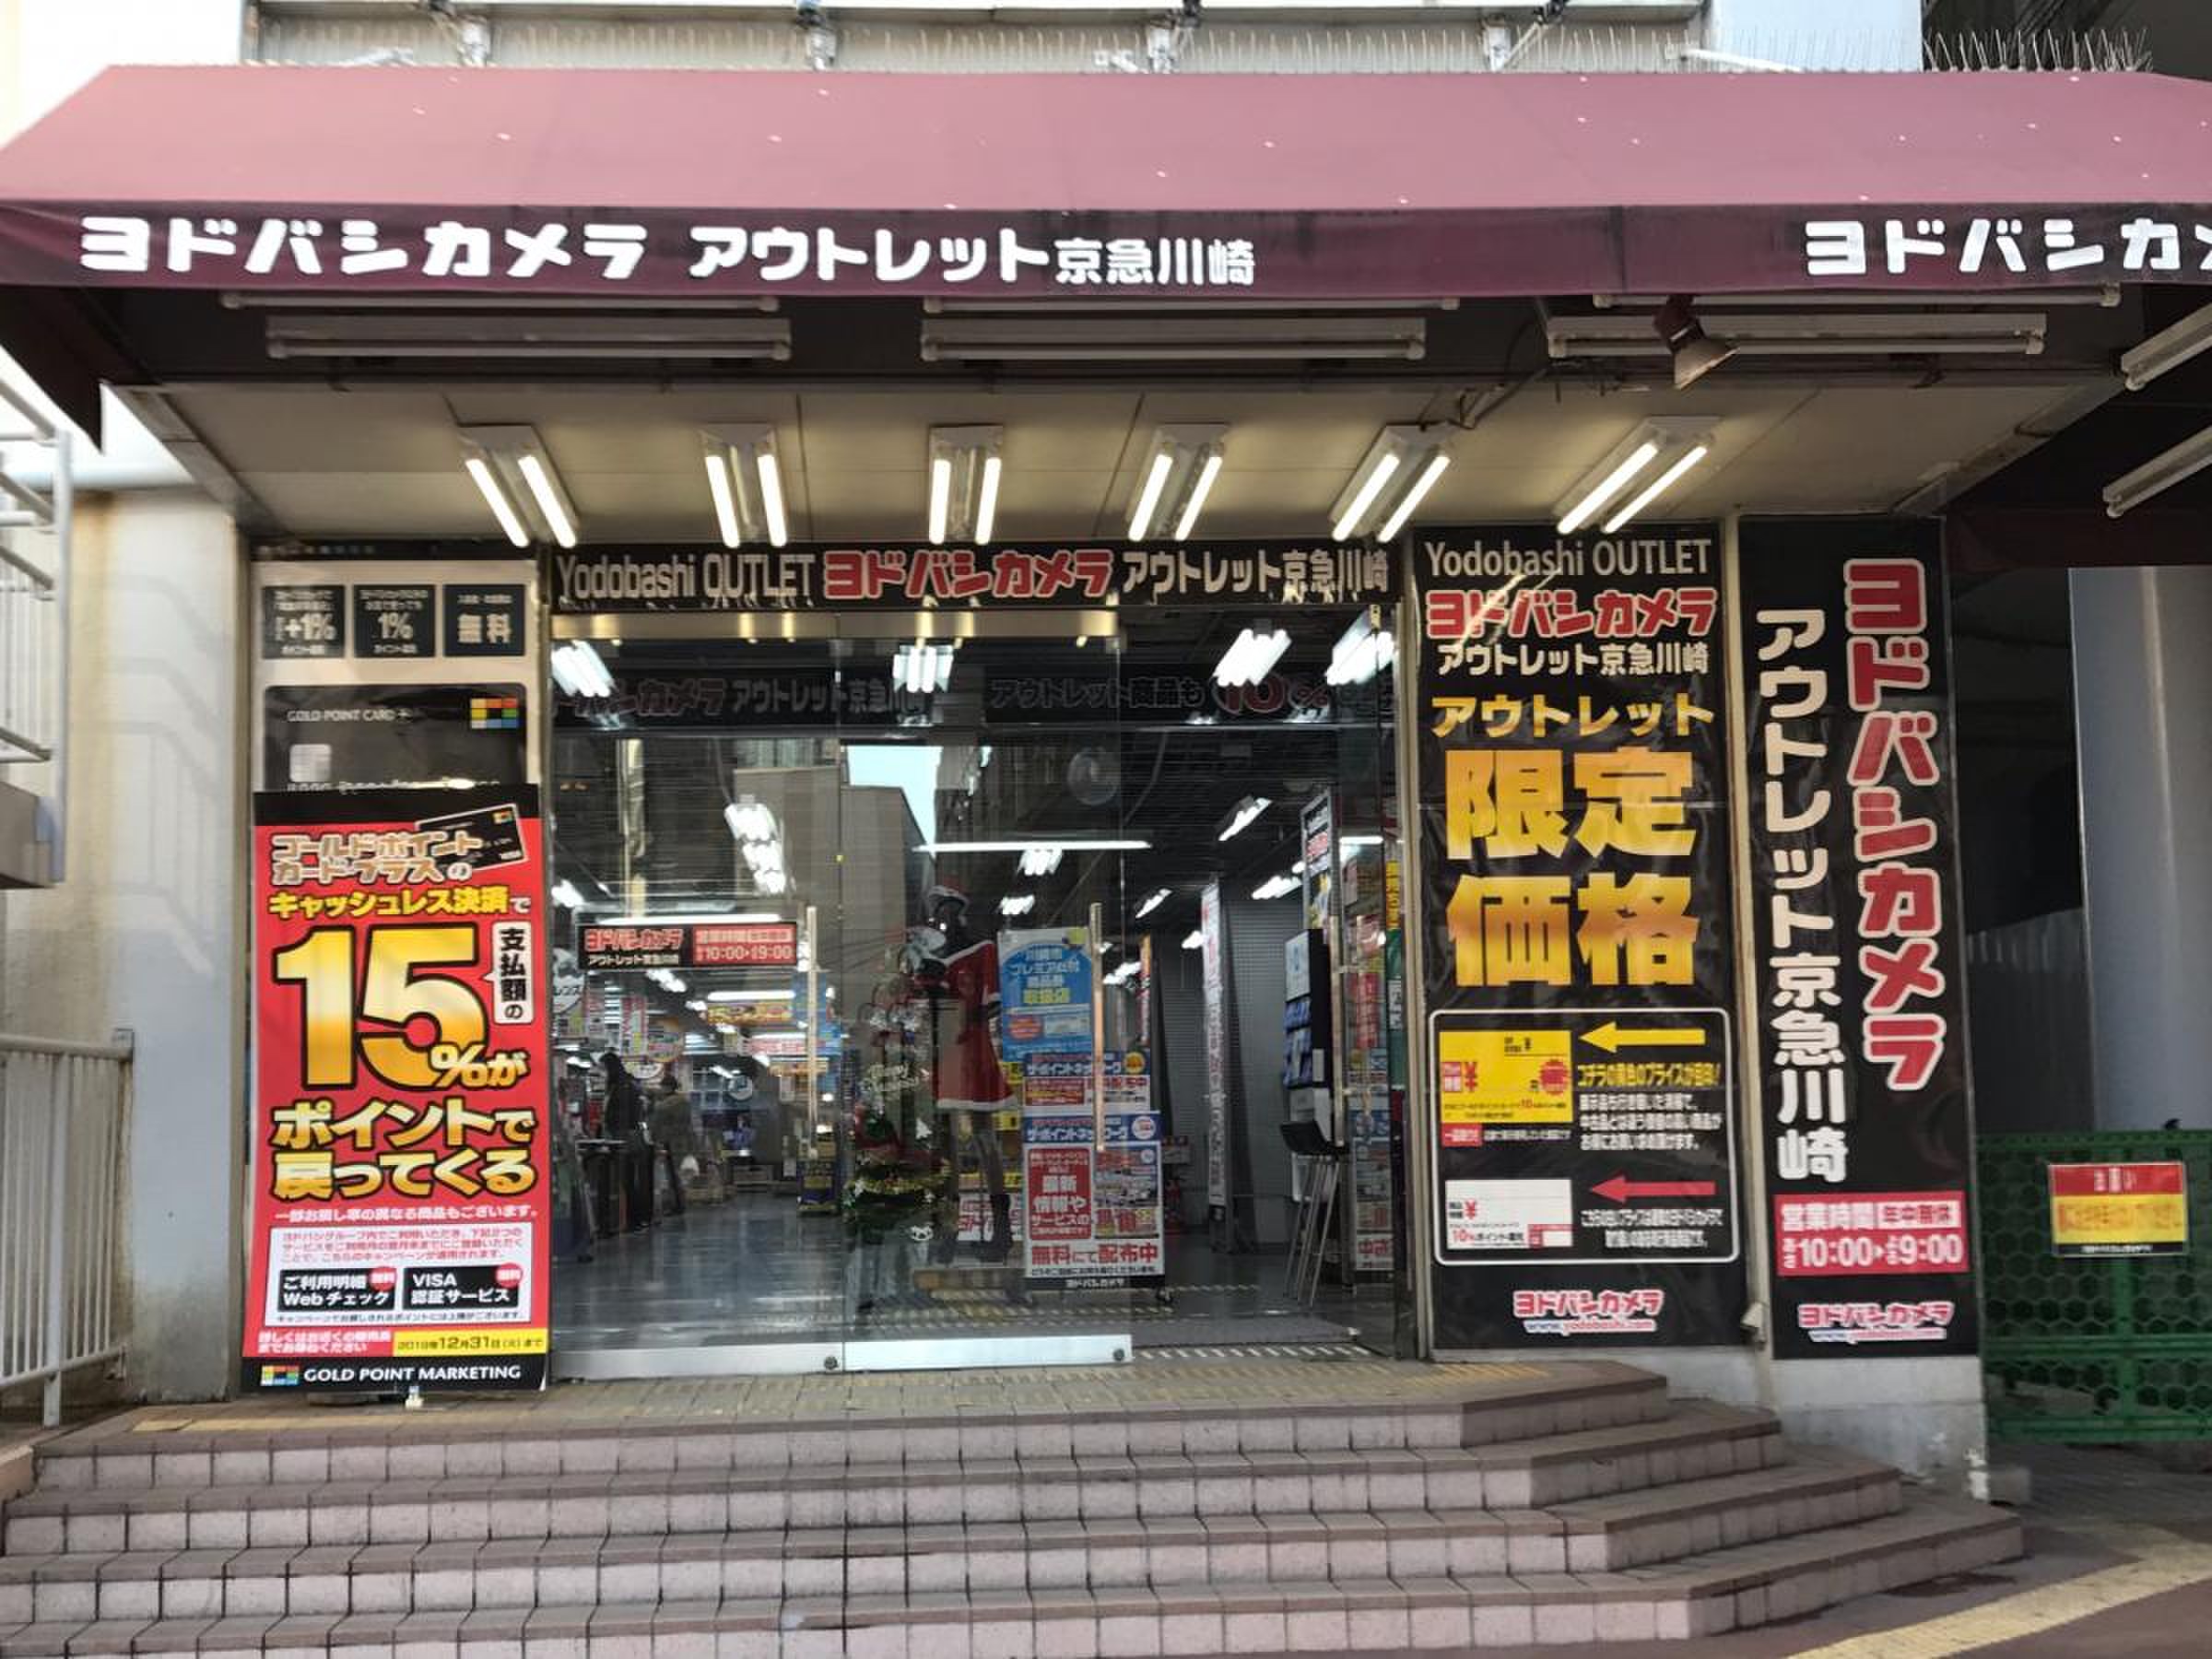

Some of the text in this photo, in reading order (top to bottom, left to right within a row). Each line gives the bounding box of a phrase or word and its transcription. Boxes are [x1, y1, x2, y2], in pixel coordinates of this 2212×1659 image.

[81, 216, 1254, 286] ヨドバシカメラ アウトレット京急川崎
[557, 549, 1390, 599] Yodobashi OUTLET ヨドバシカメラ アウトレット京急川崎
[1425, 540, 1712, 576] Yodobashi OUTLET
[1426, 588, 1719, 639] ヨドバシカメラ
[1438, 642, 1710, 676] アウトレット京急川崎
[1431, 695, 1714, 737] アウトレット
[1445, 747, 1697, 860] 限定
[1844, 559, 1947, 1091] ヨドバシカメラ
[269, 886, 532, 918] キャッシュレス決済で
[1757, 609, 1849, 1183] アウトレット京急川崎
[1445, 872, 1700, 987] 価格
[499, 928, 527, 1020] 支払額の
[706, 946, 745, 961] 10:00
[269, 1097, 538, 1149] ポイントで
[271, 1148, 538, 1201] 戻ってくる
[1799, 1237, 1875, 1267] 10:00
[1900, 1234, 1964, 1265] 9:00
[283, 1291, 390, 1306] Web チェック
[412, 1273, 457, 1288] VISA
[1513, 1290, 1665, 1318] ヨドバシカメラ
[1798, 1300, 1955, 1329] ヨドバシカメラ
[303, 1365, 522, 1382] GOLD POINT MARKETING
